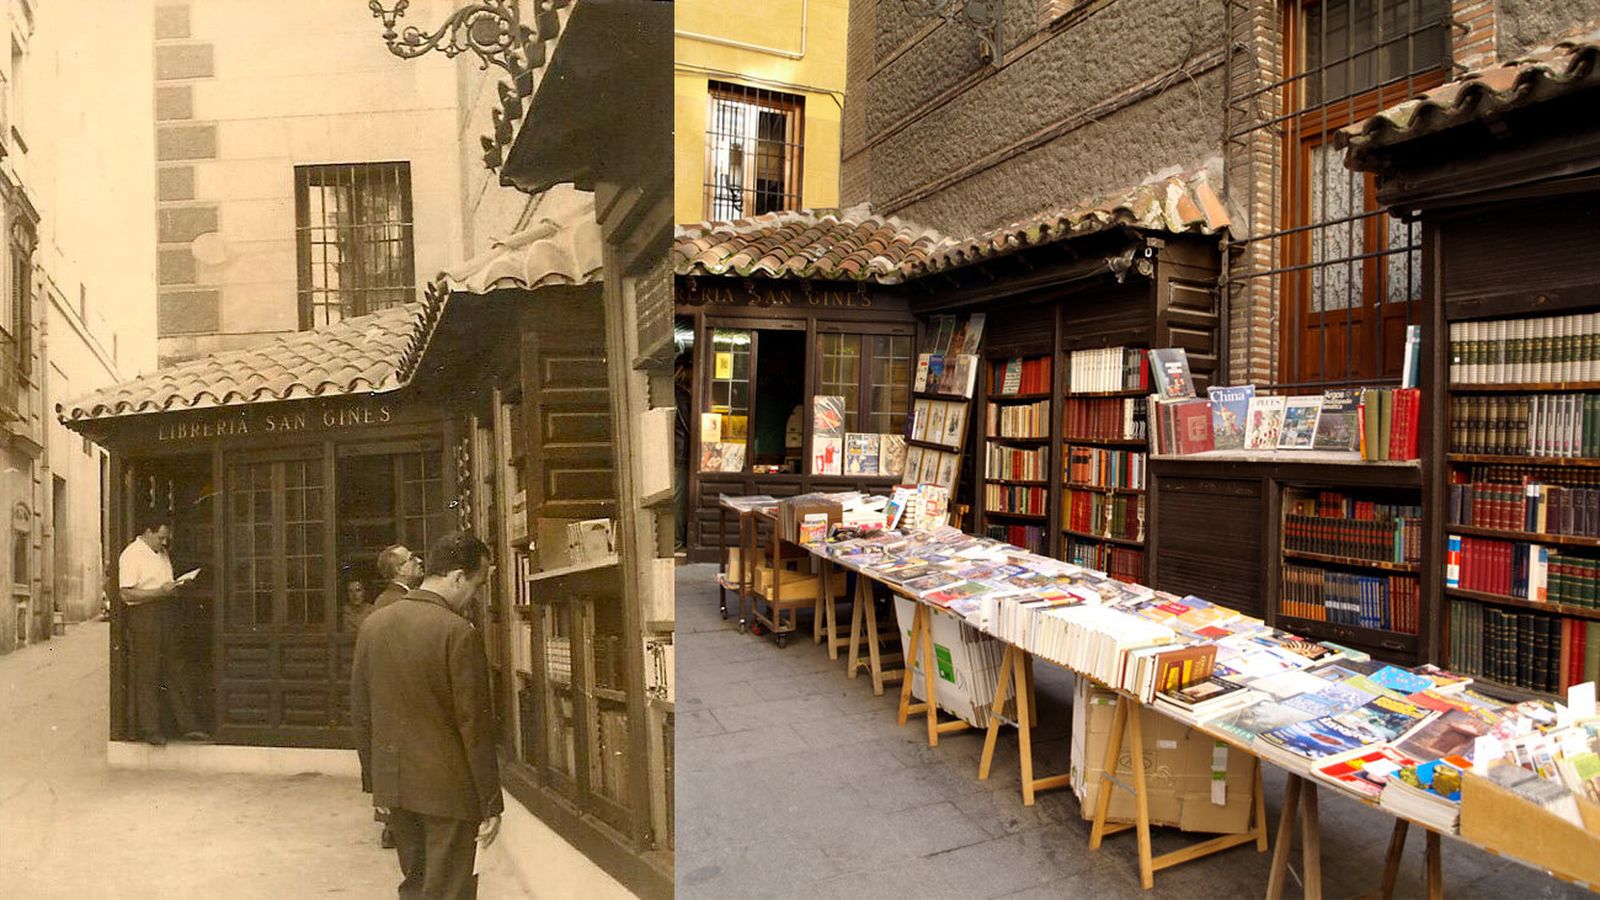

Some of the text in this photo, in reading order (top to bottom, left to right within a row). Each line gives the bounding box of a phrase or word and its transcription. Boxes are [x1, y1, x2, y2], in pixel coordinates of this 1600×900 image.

[1211, 390, 1245, 403] China
[158, 406, 390, 440] LIBRERIA SAN GINES
